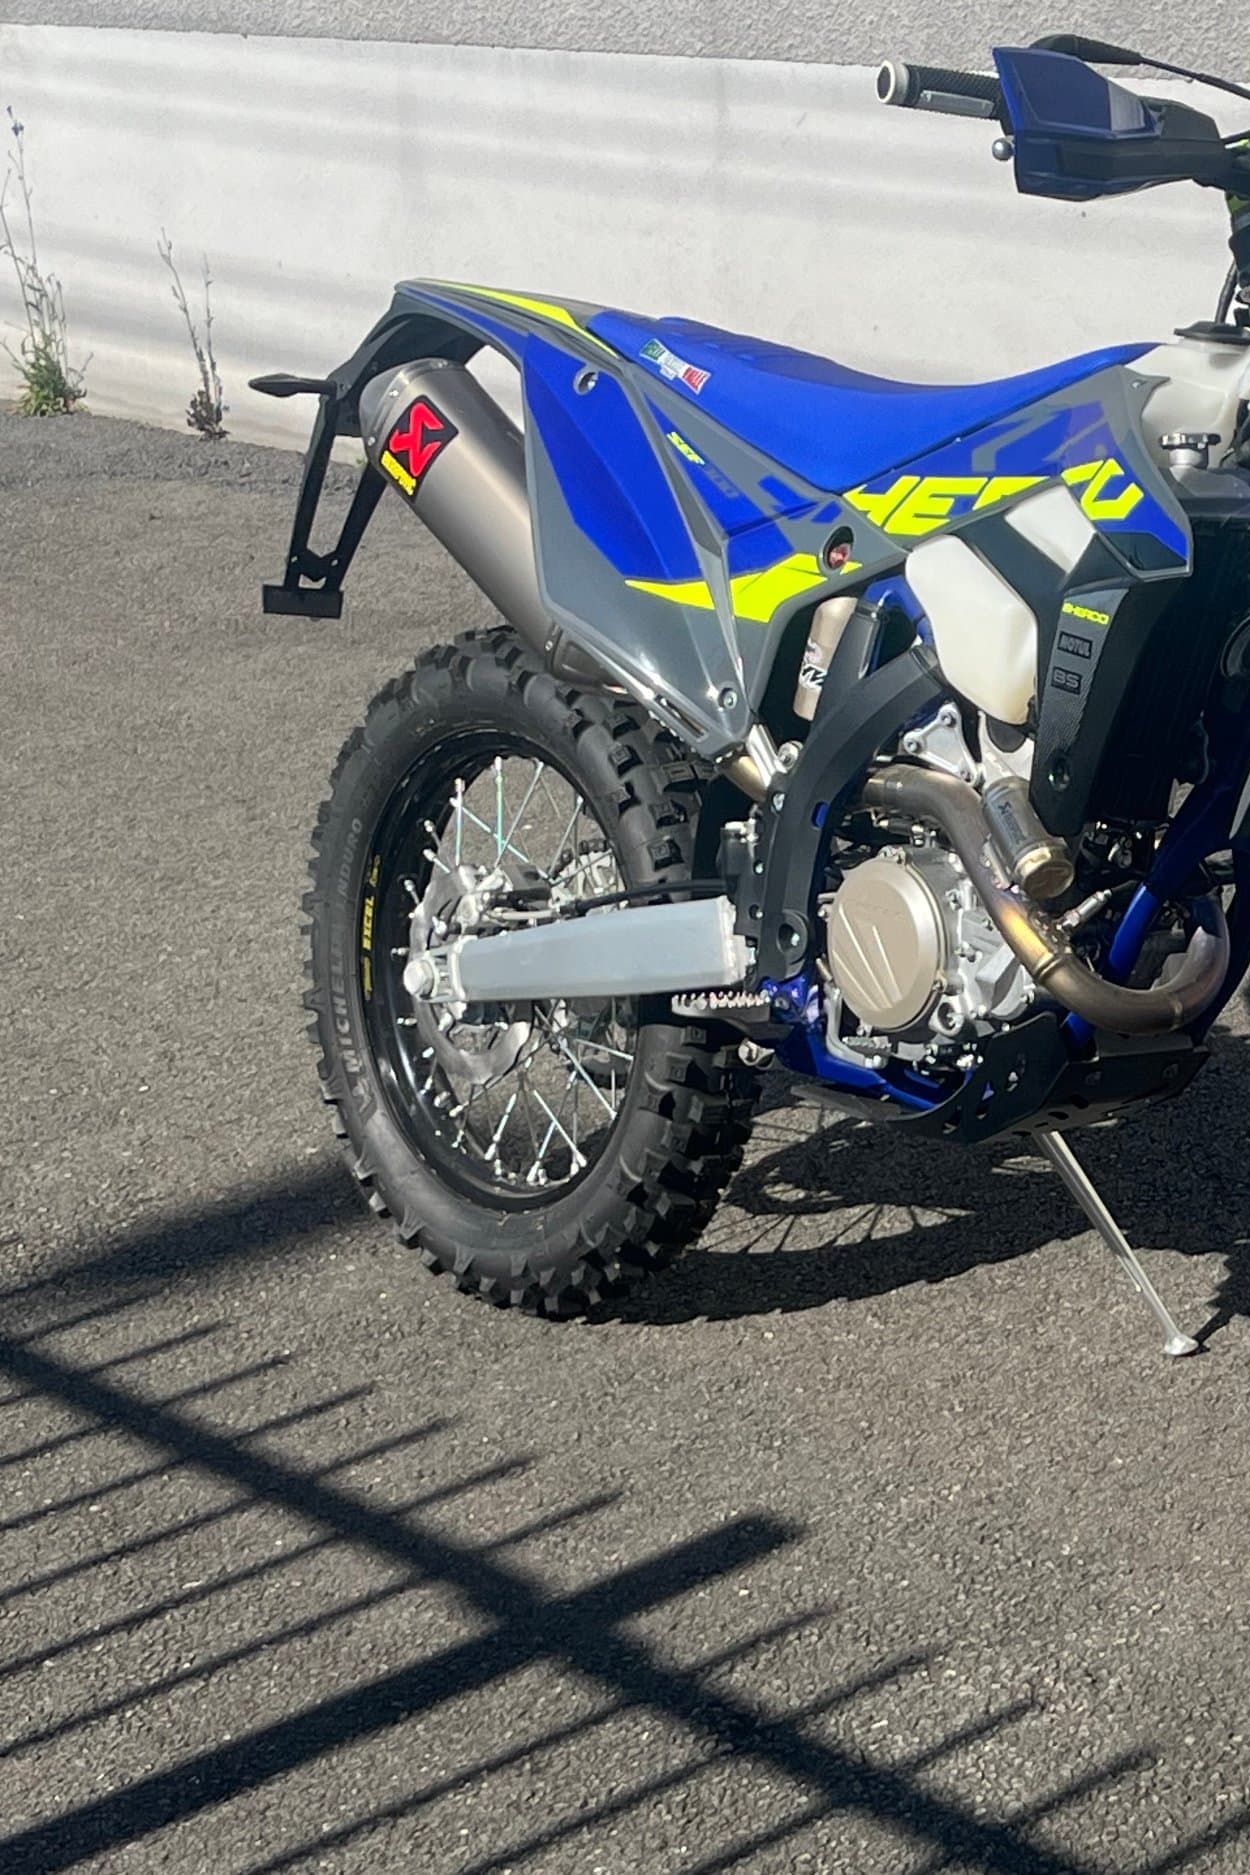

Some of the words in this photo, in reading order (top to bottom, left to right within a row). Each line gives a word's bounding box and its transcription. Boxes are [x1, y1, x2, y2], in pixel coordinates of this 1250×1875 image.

[666, 431, 706, 466] SEF
[1060, 633, 1091, 657] MOTUL
[1053, 670, 1079, 689] BS
